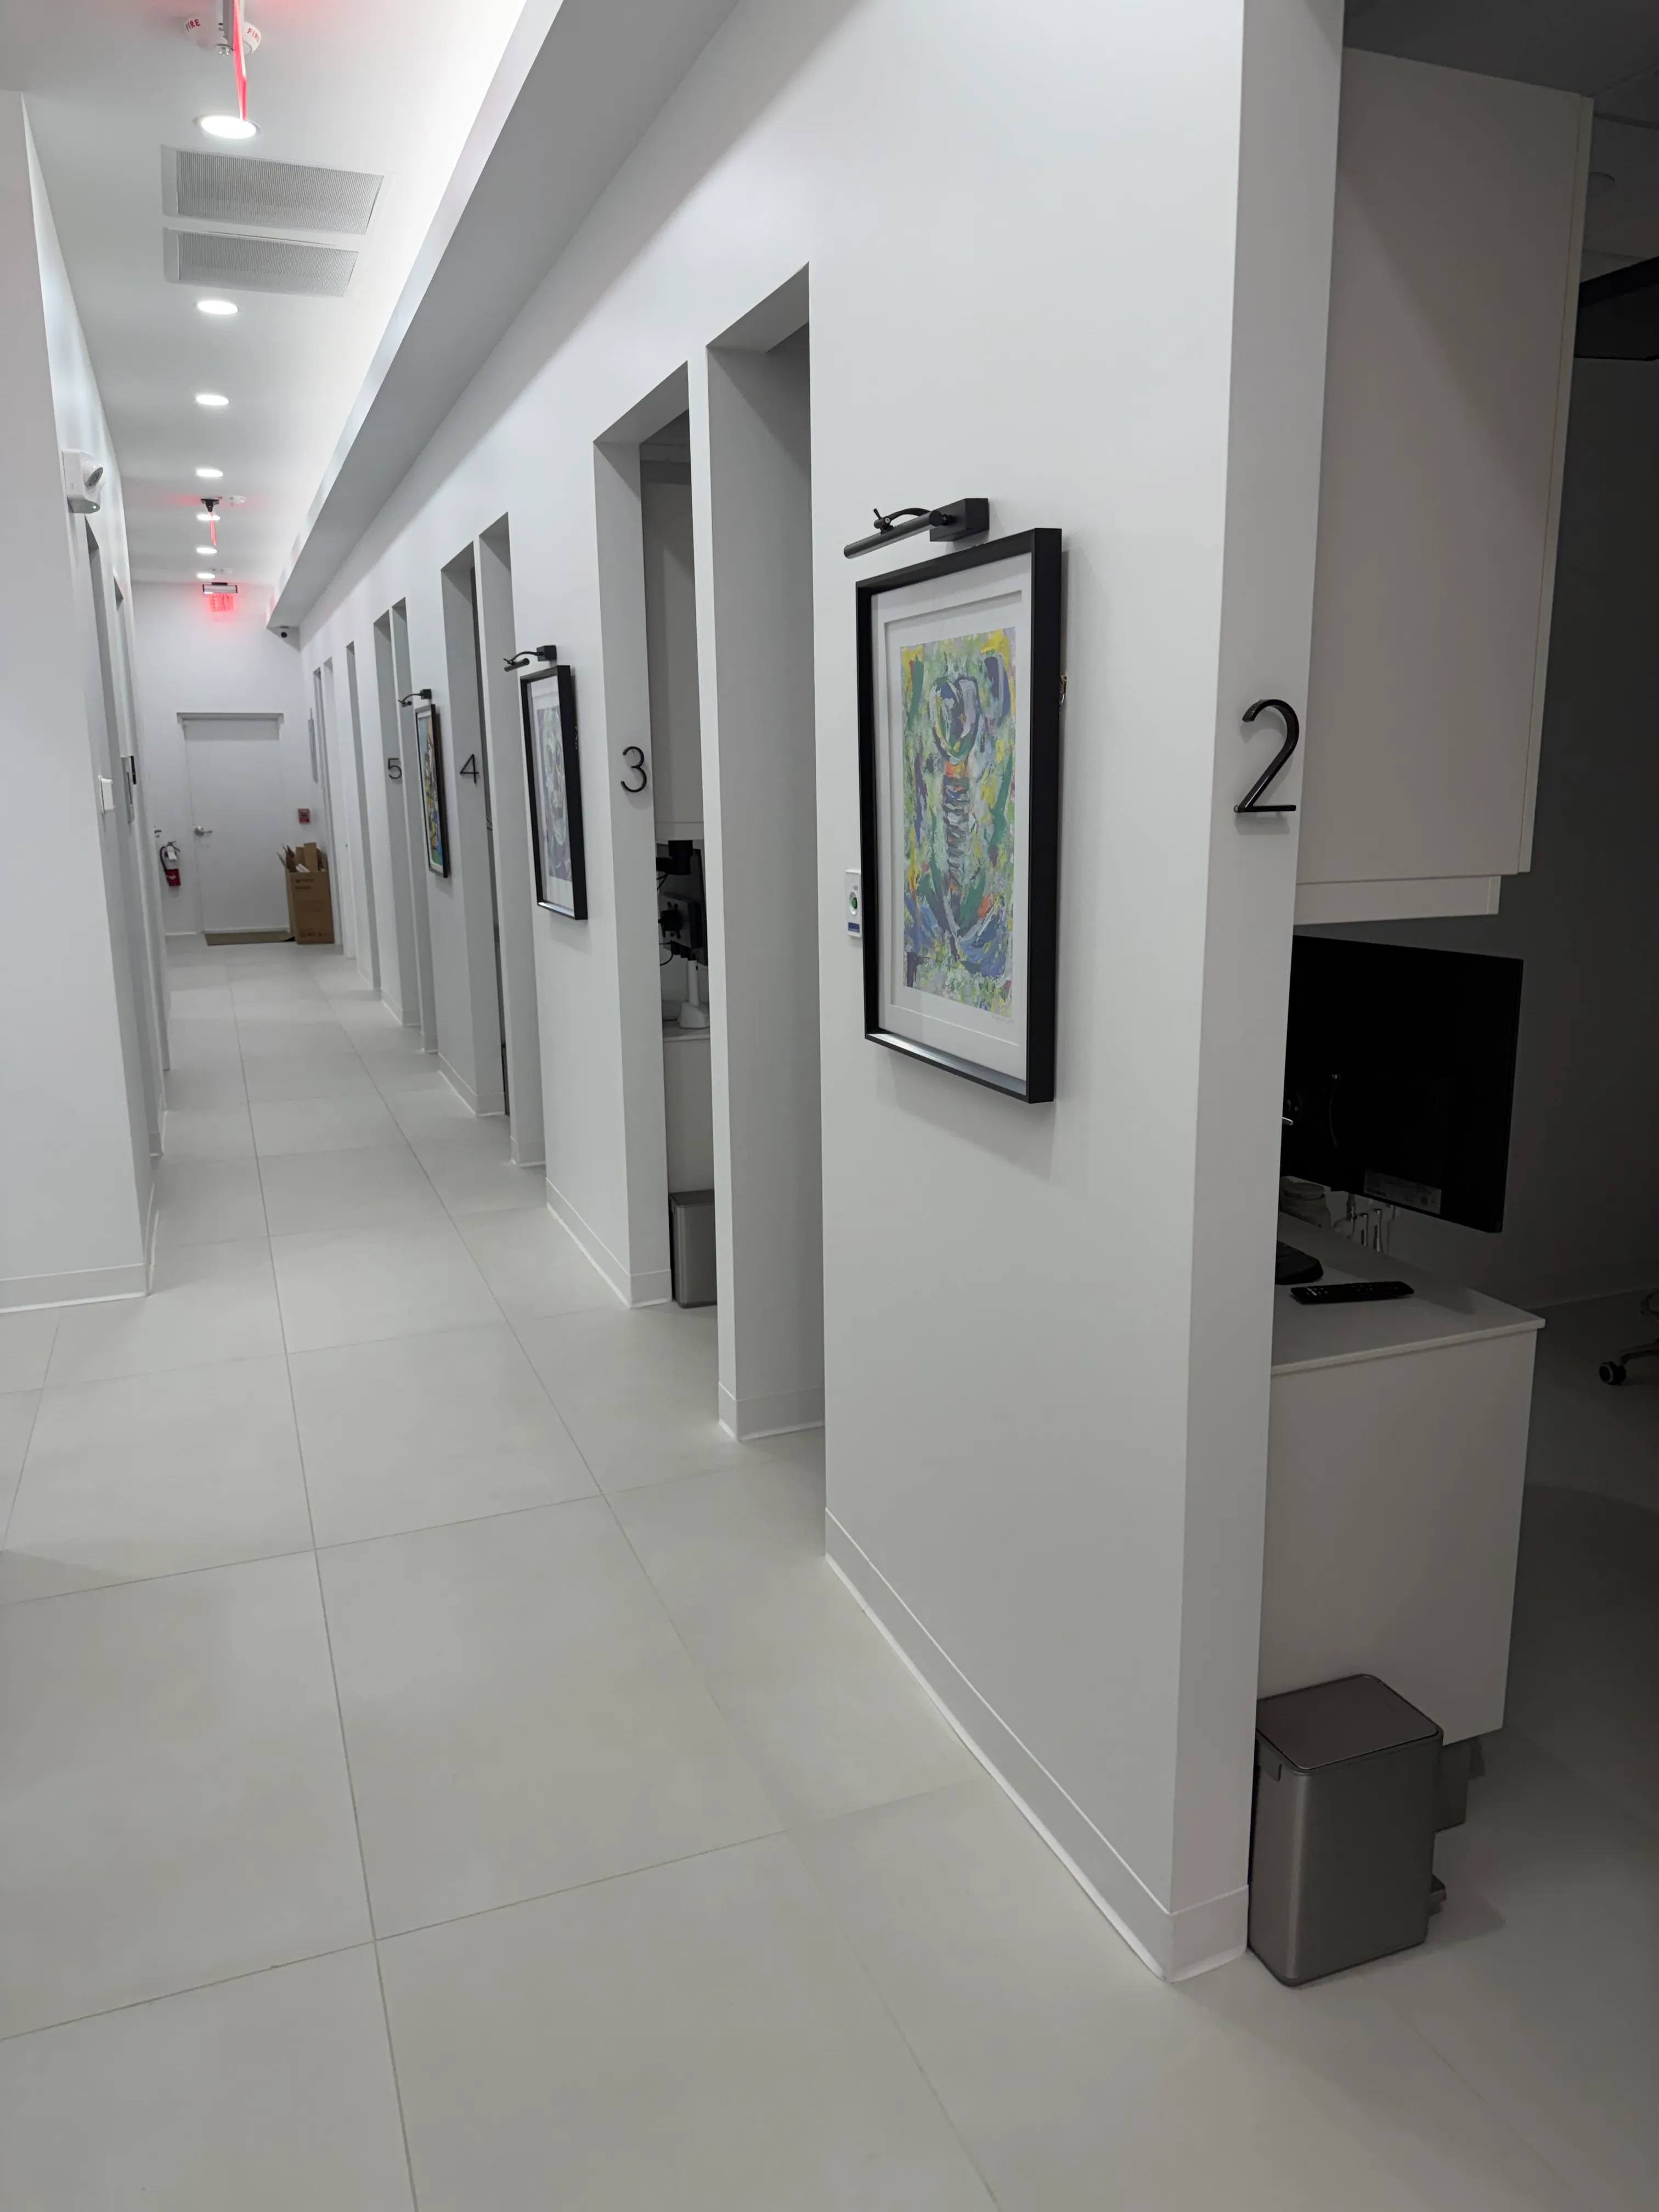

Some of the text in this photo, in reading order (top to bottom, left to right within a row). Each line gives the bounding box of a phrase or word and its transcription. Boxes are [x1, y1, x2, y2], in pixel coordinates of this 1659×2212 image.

[388, 758, 402, 780] 5
[460, 754, 479, 783] 4
[620, 746, 647, 793] 3
[1234, 699, 1299, 812] 2
